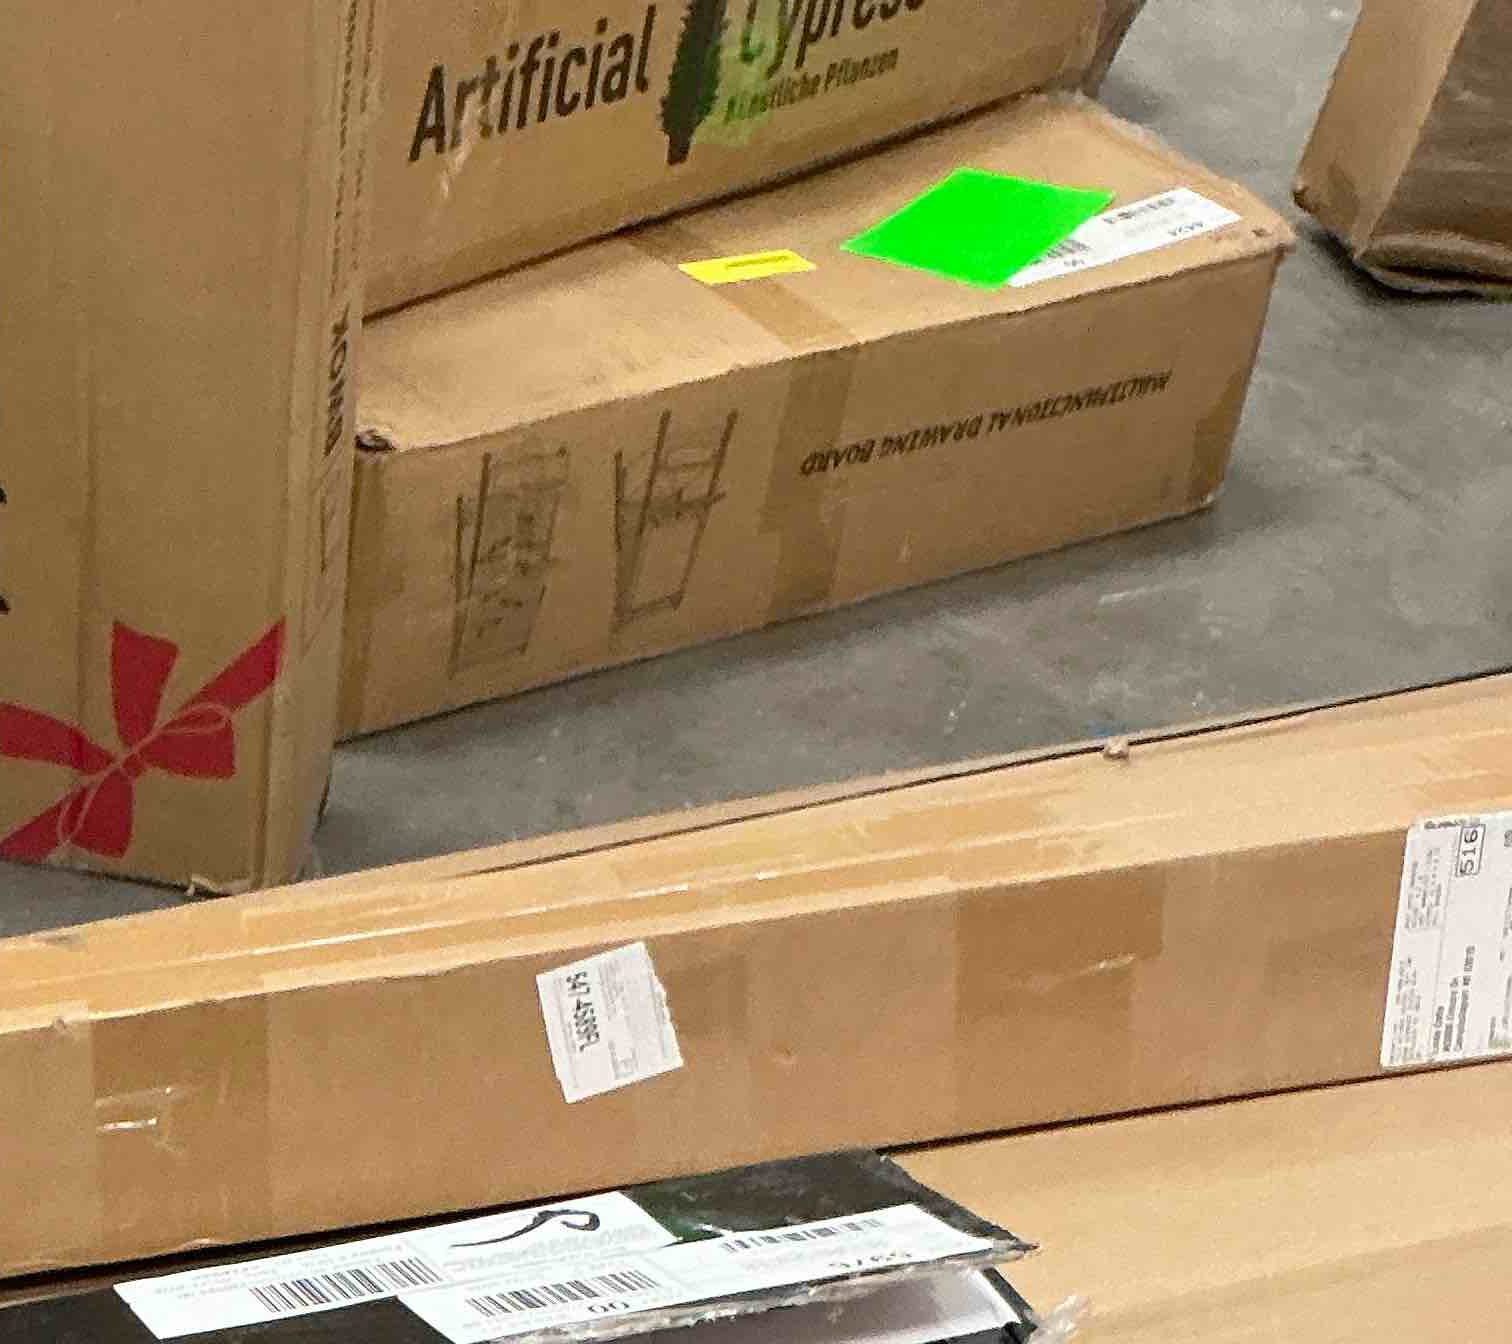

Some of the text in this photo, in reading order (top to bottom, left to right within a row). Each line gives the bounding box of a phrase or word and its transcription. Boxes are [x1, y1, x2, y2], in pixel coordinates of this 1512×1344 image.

[408, 3, 658, 162] Artificial
[800, 439, 876, 477] BOARD
[879, 415, 984, 458] DRAWING
[1460, 829, 1479, 876] 516
